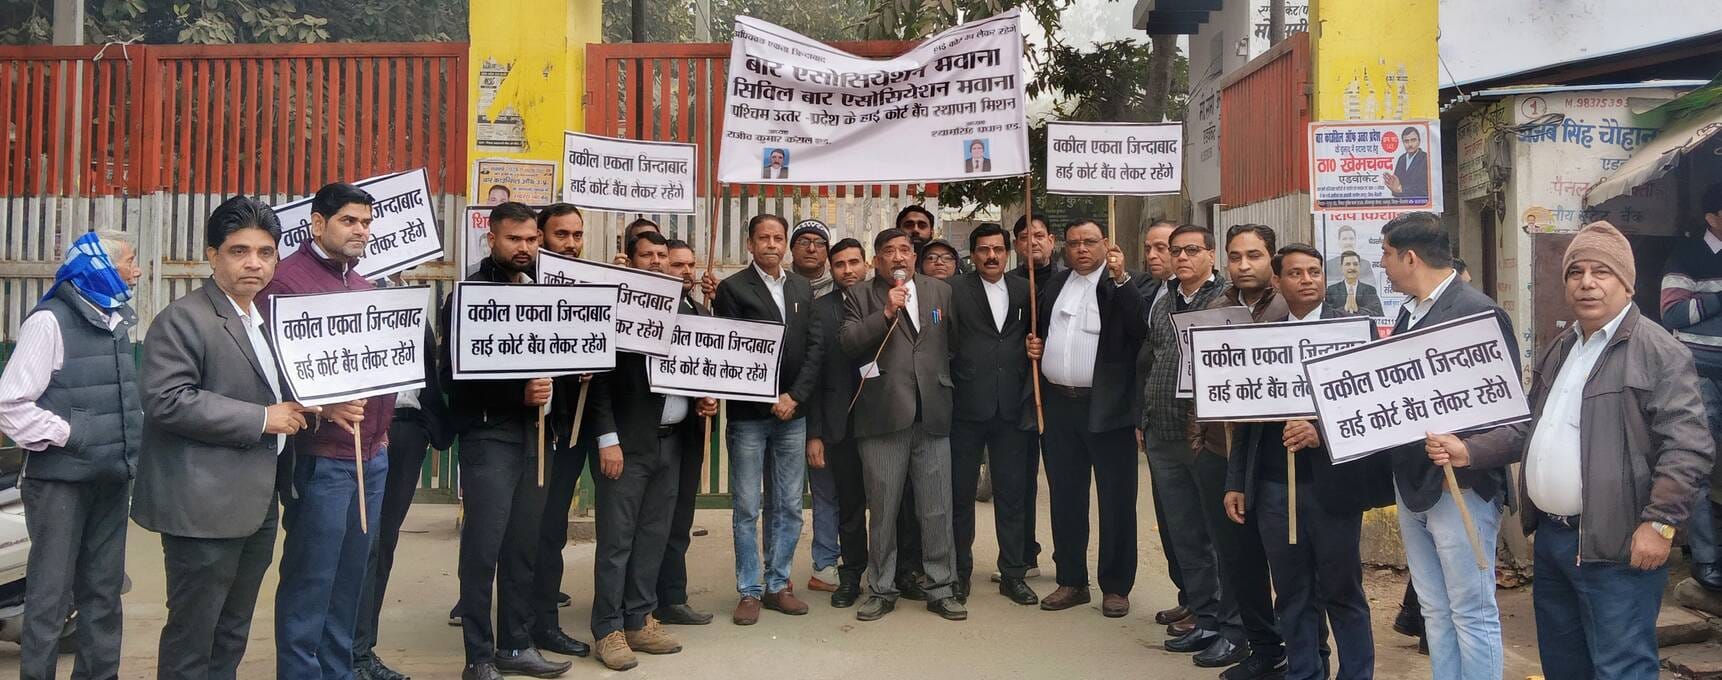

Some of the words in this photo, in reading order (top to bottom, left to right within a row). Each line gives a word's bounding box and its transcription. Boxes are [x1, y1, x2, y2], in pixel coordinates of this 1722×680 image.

[746, 54, 784, 78] बार
[793, 63, 926, 89] एसोसियेशन
[935, 48, 1000, 72] मवाना
[733, 77, 794, 102] सिविल
[802, 90, 833, 107] बार
[842, 79, 950, 107] एसोसियेशन
[956, 74, 1015, 94] मवाना
[730, 103, 770, 120] पश्चिम
[773, 109, 802, 123] उत्तर
[845, 110, 857, 124] के
[885, 106, 909, 122] कोर्ट
[932, 102, 977, 117] स्थापना
[980, 97, 1016, 112] मिशन
[1053, 134, 1086, 154] वकील
[1091, 140, 1122, 155] एकता
[1127, 136, 1178, 155] जिन्दाबाद
[569, 148, 599, 168] वकील
[604, 155, 634, 172] एकता
[638, 154, 688, 175] जिन्दाबाद
[1056, 162, 1074, 181] हाई
[1076, 162, 1098, 180] कोर्ट
[1101, 162, 1116, 180] बैंच
[1120, 162, 1146, 181] लेकर
[1150, 162, 1174, 180] रहेंगे
[1340, 153, 1395, 173] खेमचन्द
[570, 176, 586, 194] हाई
[589, 177, 610, 196] कोर्ट
[613, 179, 627, 198] बैंच
[631, 181, 657, 199] लेकर
[661, 181, 685, 200] रहेंगे
[1338, 172, 1379, 185] एडवोकेट
[369, 229, 397, 256] लेकर
[400, 217, 428, 245] रहेंगे
[467, 298, 510, 323] वकील
[515, 303, 553, 322] एकता
[556, 300, 612, 323] जिन्दाबाद
[617, 282, 675, 313] जिन्दाबाद
[283, 311, 323, 341] वकील
[327, 312, 362, 337] एकता
[366, 304, 424, 332] जिन्दाबाद
[637, 318, 664, 341] रहेंगे
[471, 335, 494, 357] हाई
[498, 333, 525, 356] कोर्ट
[527, 332, 546, 355] बैंच
[549, 332, 578, 355] लेकर
[581, 332, 607, 354] रहेंगे
[695, 332, 726, 350] एकता
[727, 330, 777, 356] जिन्दाबाद
[1201, 342, 1247, 368] वकील
[1251, 344, 1294, 366] एकता
[293, 353, 315, 381] हाई
[317, 350, 339, 377] कोर्ट
[342, 347, 359, 374] बैंच
[361, 344, 389, 372] लेकर
[391, 340, 416, 366] रहेंगे
[659, 355, 678, 376] हाई
[679, 355, 700, 376] कोर्ट
[702, 357, 717, 378] बैंच
[719, 359, 745, 381] लेकर
[746, 361, 768, 383] रहेंगे
[1320, 369, 1375, 401] वकील
[1375, 357, 1425, 389] एकता
[1425, 338, 1504, 377] जिन्दाबाद
[1207, 379, 1232, 404] हाई
[1236, 377, 1263, 401] कोर्ट
[1267, 376, 1289, 400] बैंच
[1337, 412, 1367, 441] हाई
[1367, 404, 1401, 433] कोर्ट
[1402, 398, 1429, 424] बैंच
[1429, 390, 1473, 417] लेकर
[1474, 374, 1513, 404] रहेंगे
